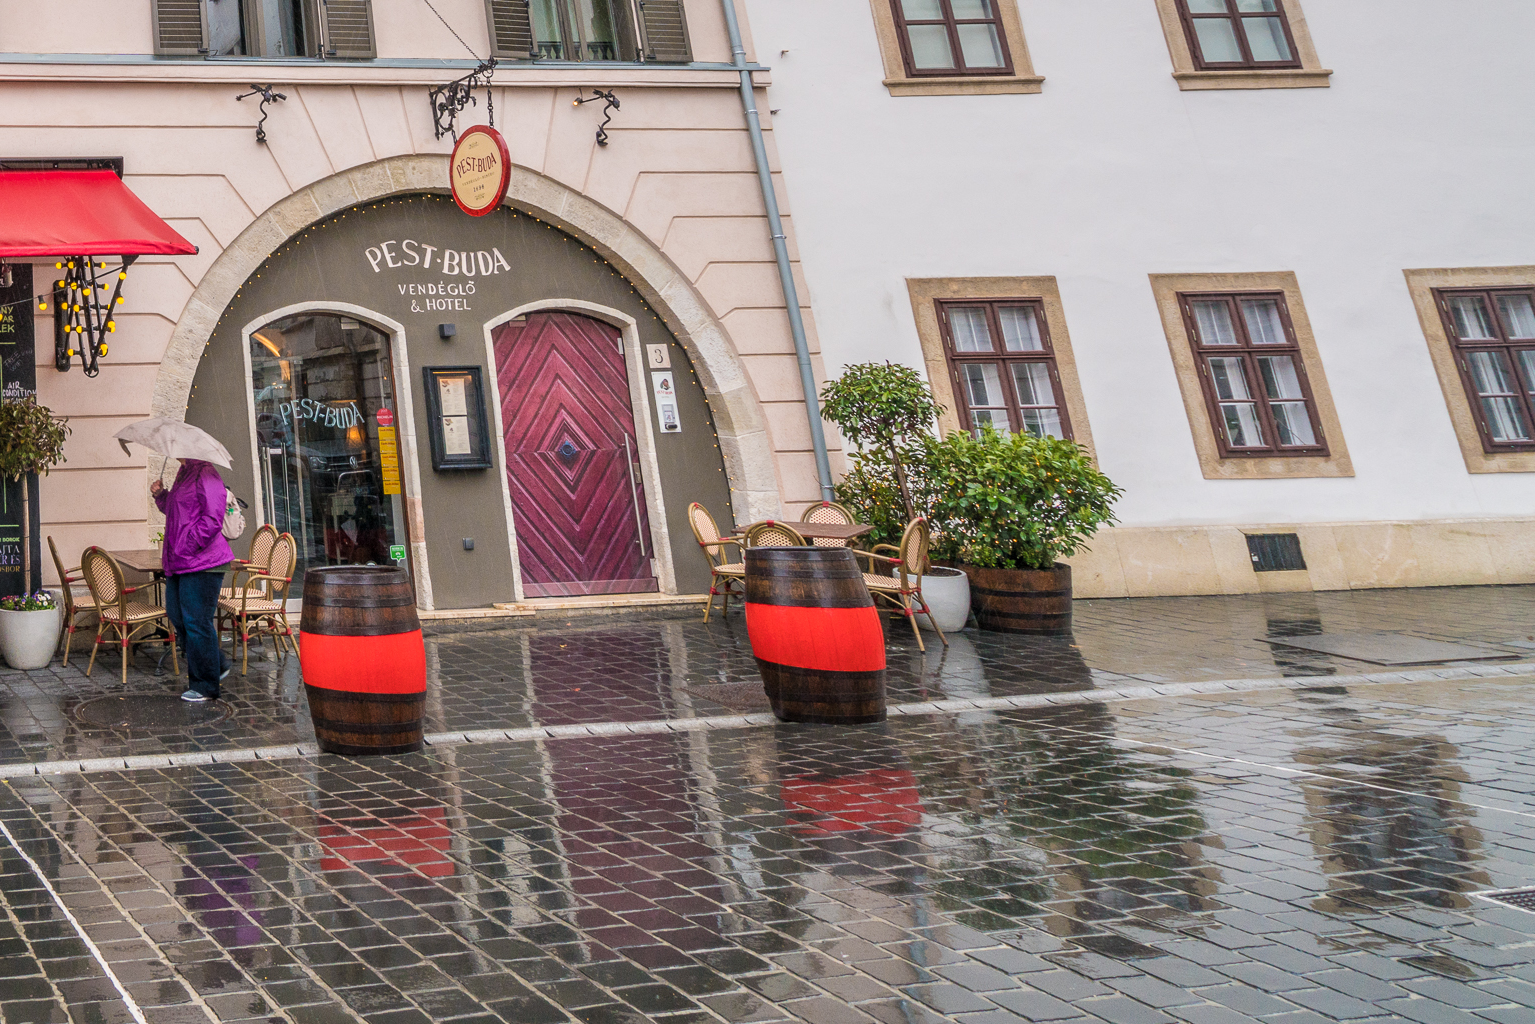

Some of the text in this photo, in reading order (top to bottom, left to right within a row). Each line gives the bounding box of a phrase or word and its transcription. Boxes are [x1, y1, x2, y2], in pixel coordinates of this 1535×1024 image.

[398, 281, 476, 295] VENDÉGLŐ
[411, 298, 472, 313] & HOTEL
[654, 348, 663, 364] 3
[7, 381, 23, 389] AIR
[279, 398, 365, 429] PEST-BUDA
